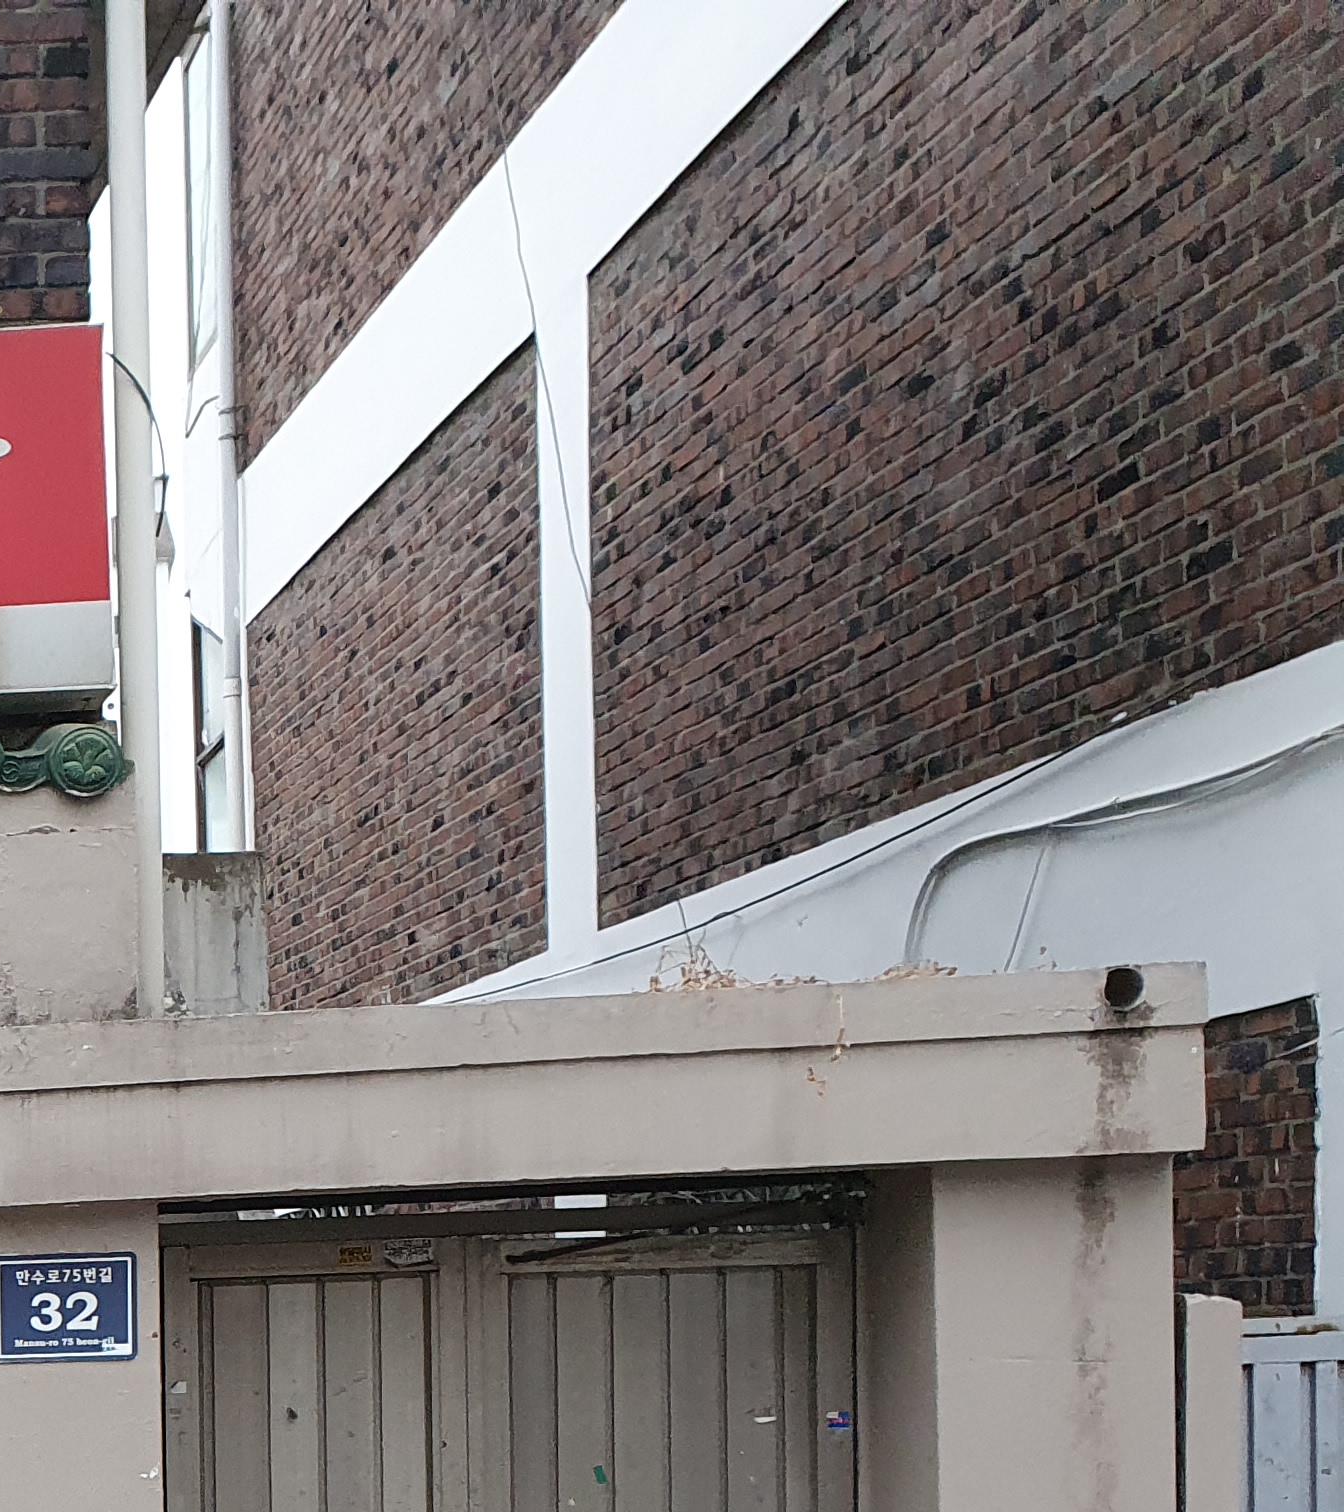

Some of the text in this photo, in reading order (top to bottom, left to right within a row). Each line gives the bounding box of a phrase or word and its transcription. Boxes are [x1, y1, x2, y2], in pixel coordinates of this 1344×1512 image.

[15, 1266, 113, 1286] 만수로75번길
[30, 1291, 99, 1332] 32
[61, 1337, 74, 1347] 75
